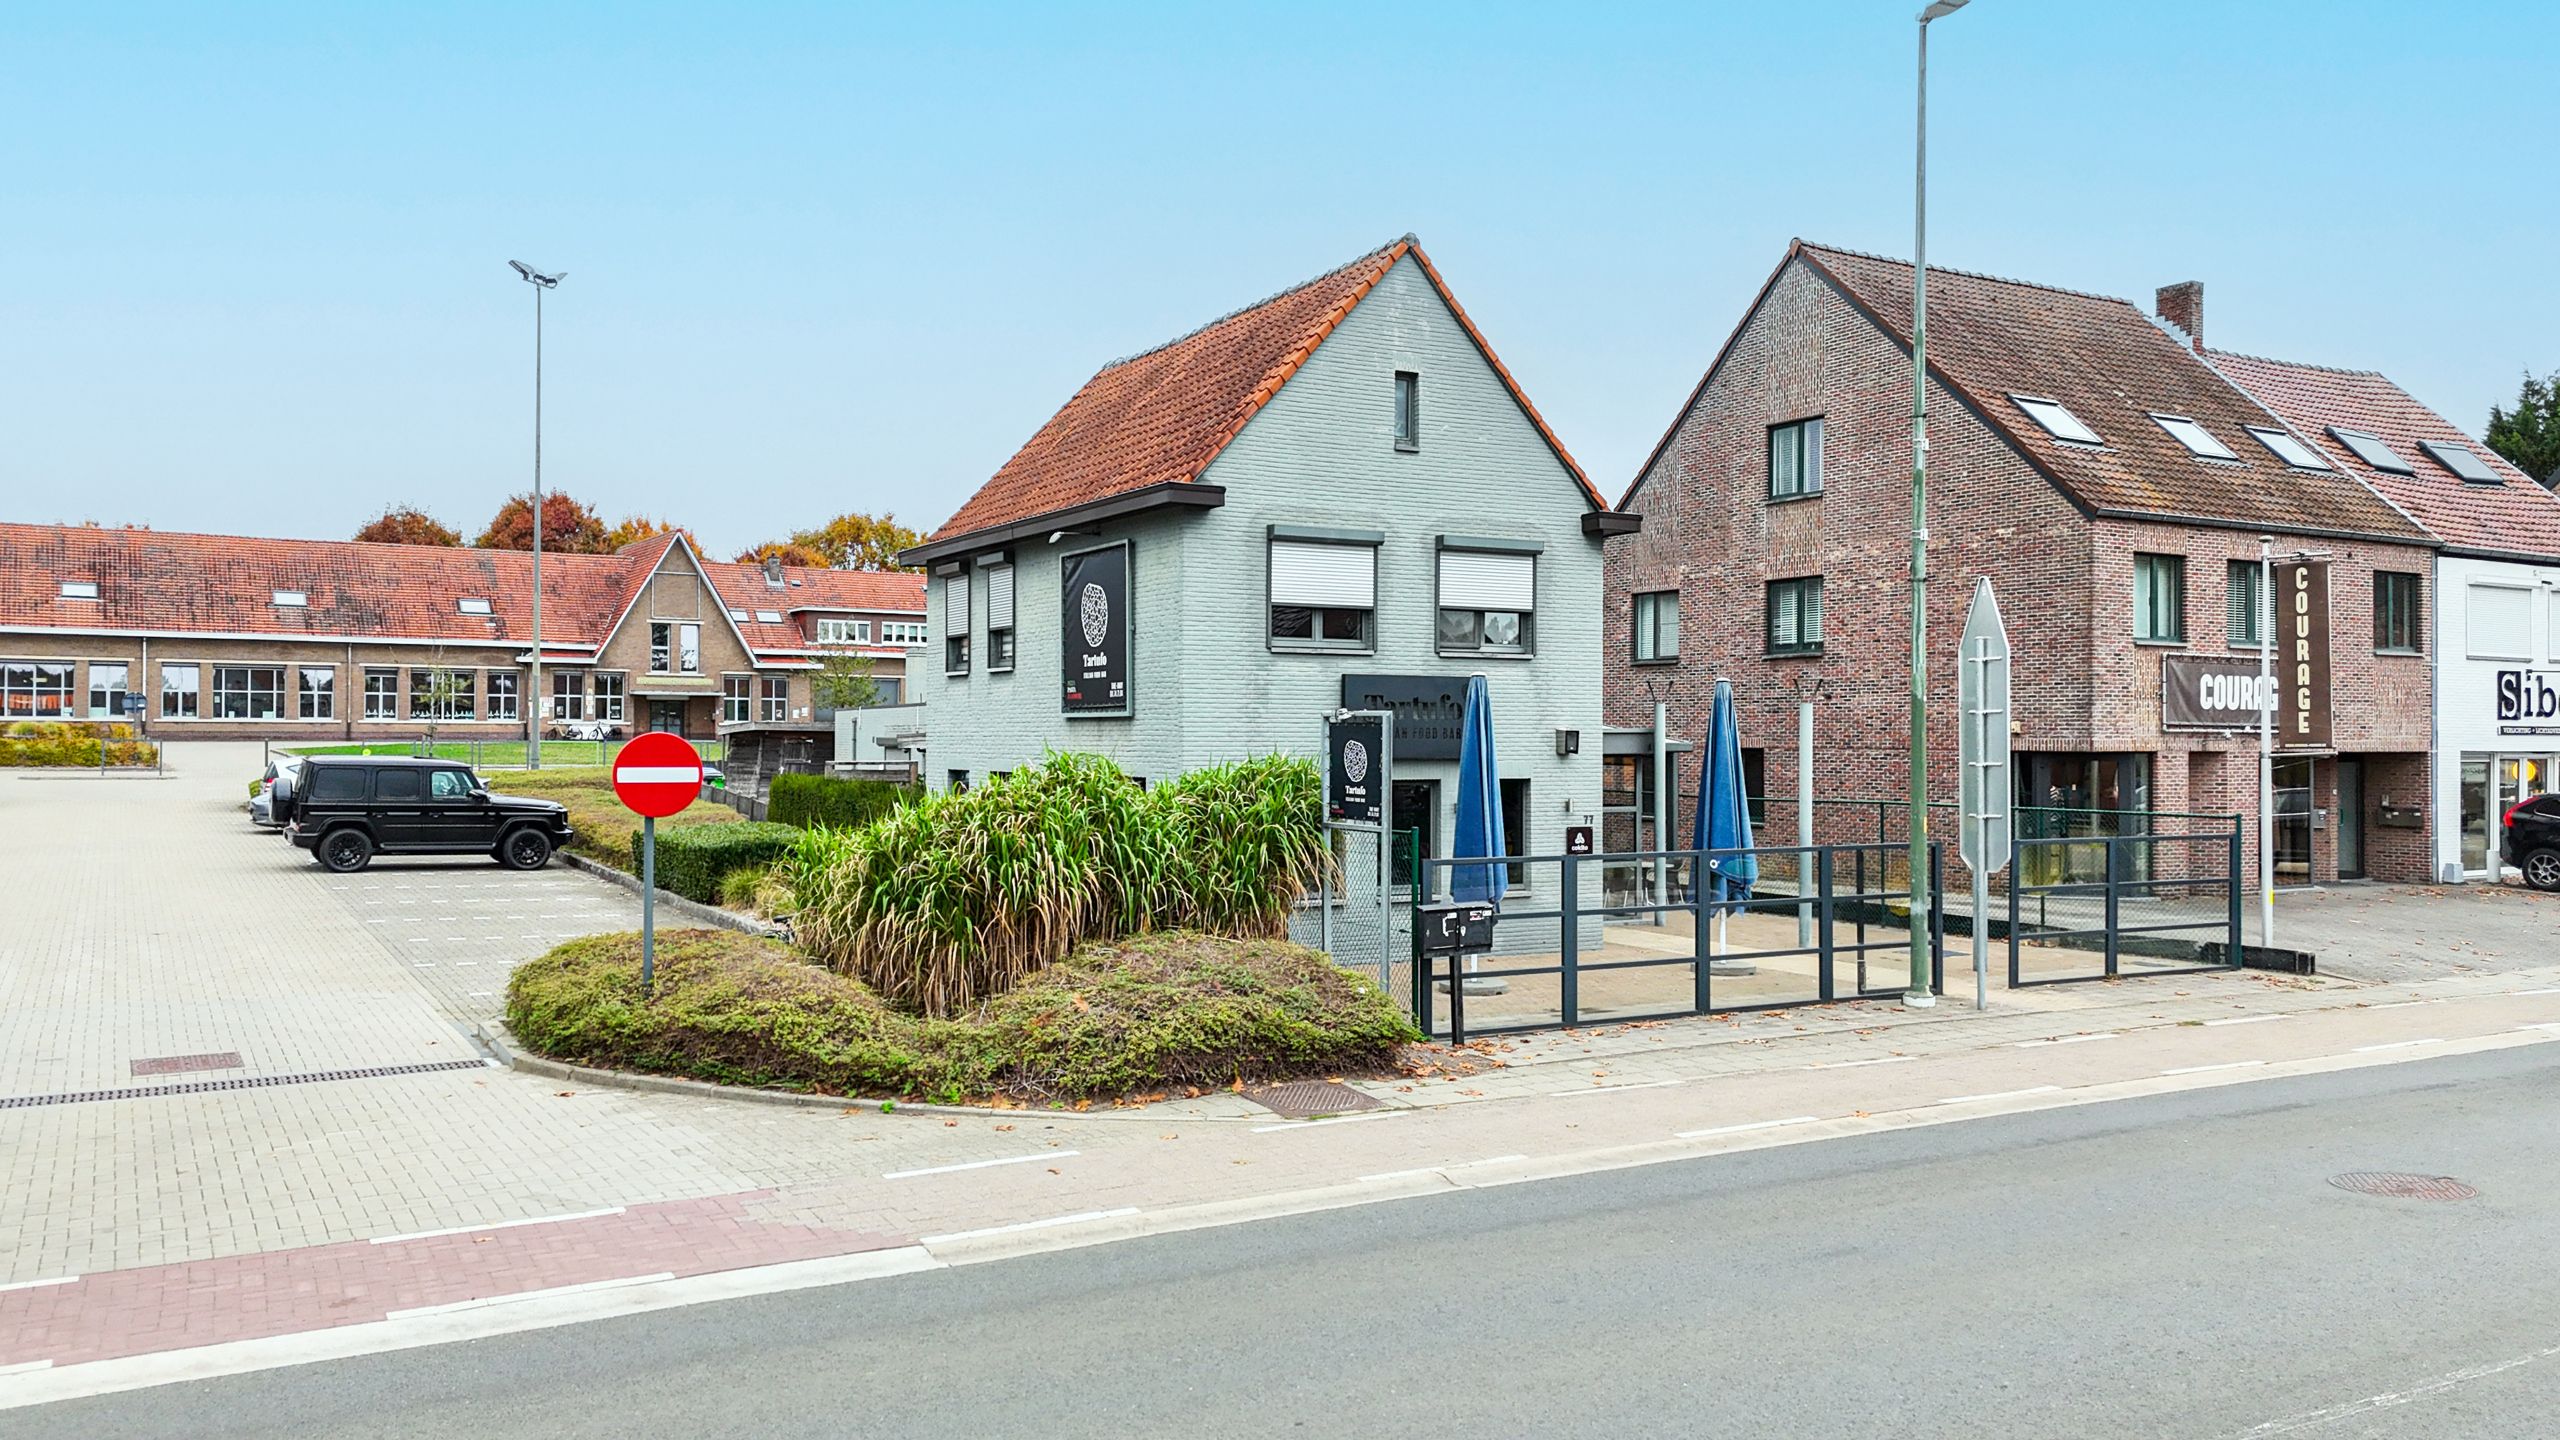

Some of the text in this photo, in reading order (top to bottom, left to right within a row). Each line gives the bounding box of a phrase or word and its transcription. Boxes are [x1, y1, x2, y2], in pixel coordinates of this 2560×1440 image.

[1082, 651, 1107, 668] Tartufo
[2295, 567, 2311, 734] COURAGE
[2200, 674, 2279, 711] COURAG
[2497, 669, 2560, 720] Sib
[1364, 694, 1463, 720] Tartufo
[1413, 727, 1438, 739] FOOD
[1443, 727, 1461, 739] BAR
[1345, 785, 1366, 795] Tartufo
[1584, 815, 1594, 824] 77
